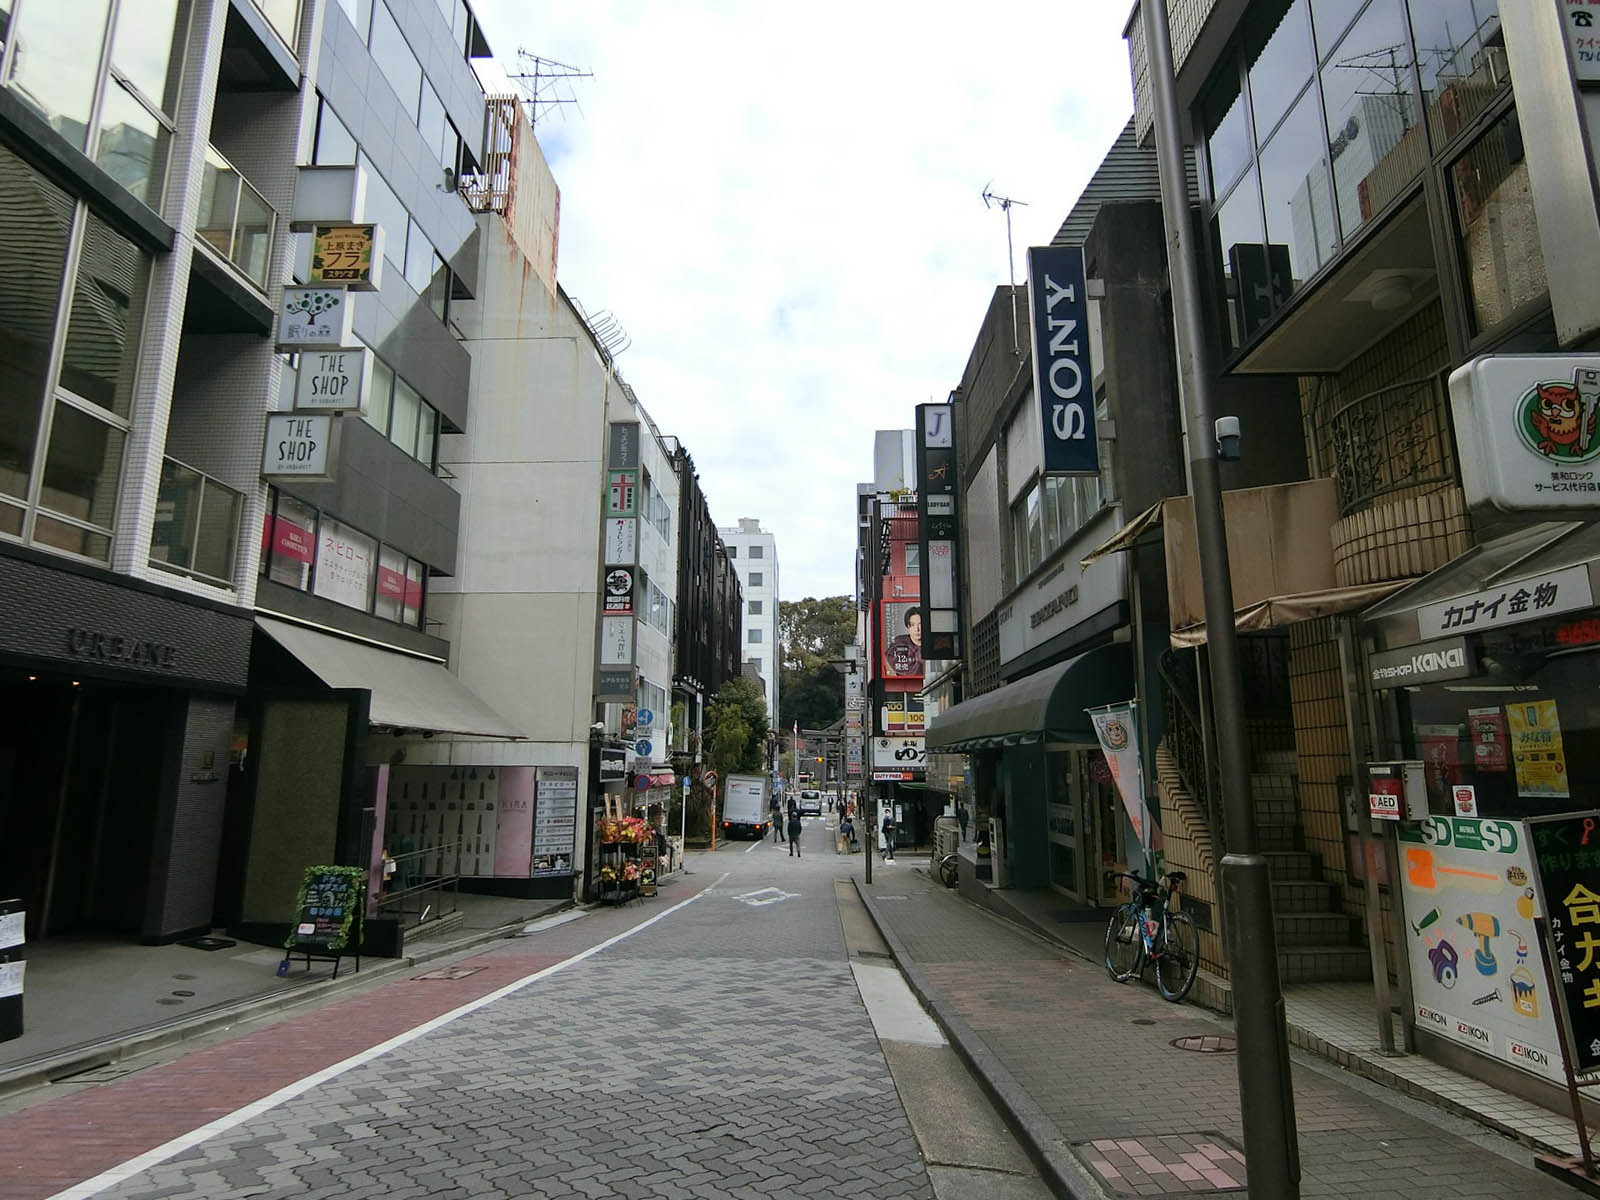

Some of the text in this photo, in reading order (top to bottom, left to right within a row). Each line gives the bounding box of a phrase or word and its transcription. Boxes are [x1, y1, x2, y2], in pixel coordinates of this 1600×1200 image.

[327, 251, 360, 267] フラ
[319, 354, 346, 373] THE
[1044, 274, 1085, 440] SONY
[311, 375, 349, 396] SHOP
[287, 419, 313, 438] THE
[278, 440, 316, 461] SHOP
[1550, 471, 1594, 480] 美和ロック
[1441, 581, 1558, 629] カナイ金物
[1377, 797, 1395, 807] AED
[1480, 819, 1518, 854] SD
[1552, 917, 1574, 984] カナイ金物
